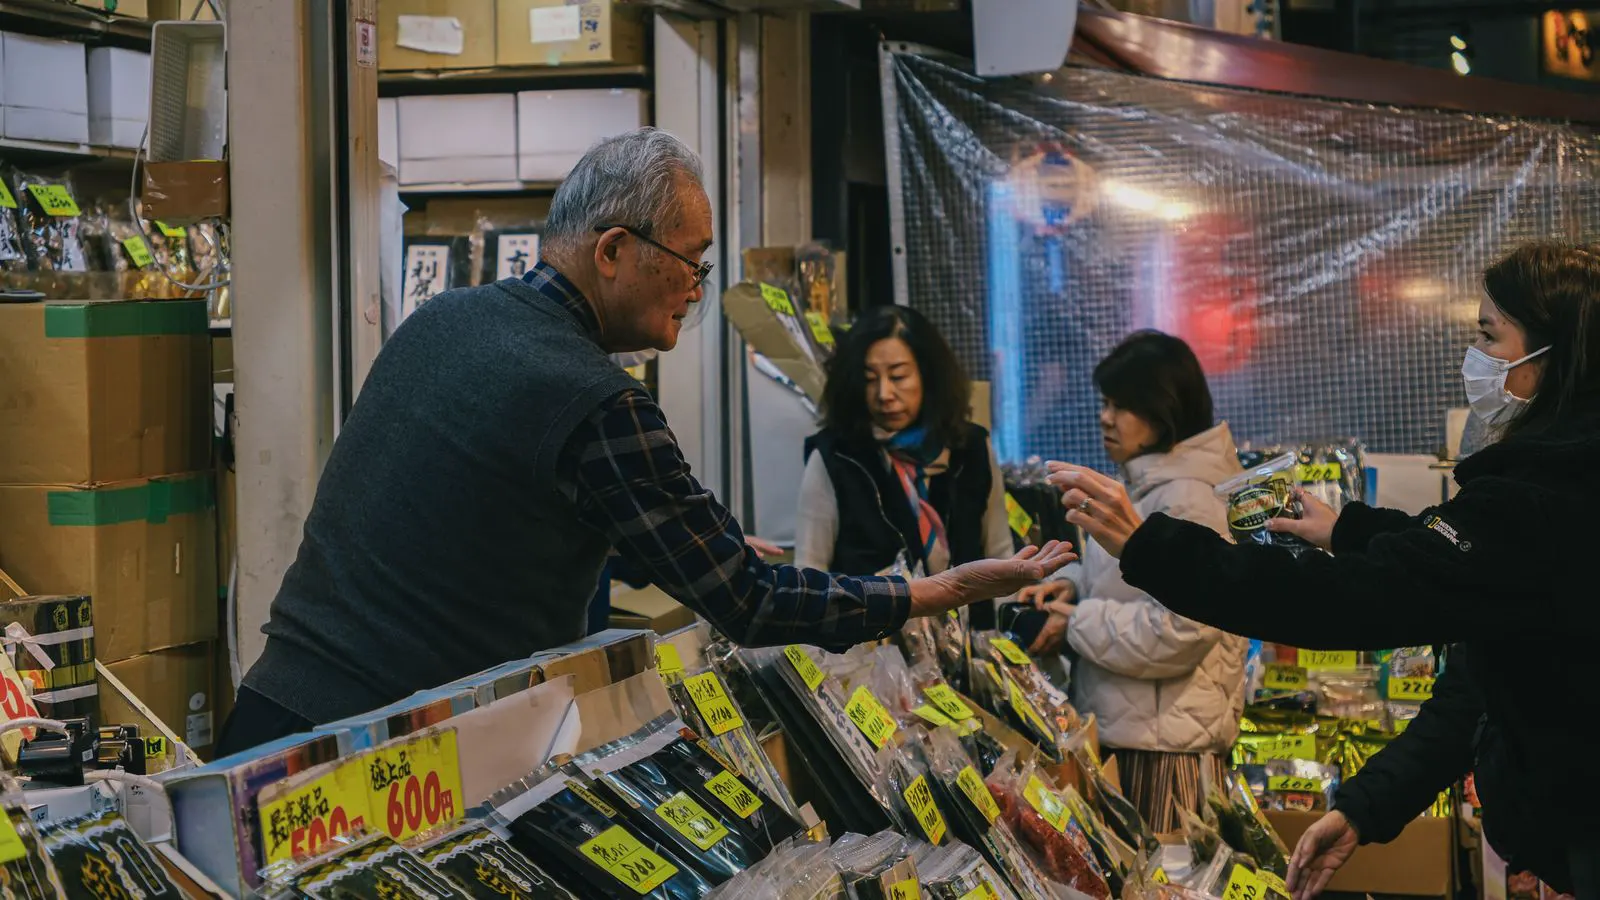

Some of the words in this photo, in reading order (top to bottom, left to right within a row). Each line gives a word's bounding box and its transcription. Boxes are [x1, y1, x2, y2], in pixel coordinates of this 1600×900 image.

[1433, 524, 1460, 546] GEOGRAPHIC
[1439, 520, 1458, 536] NATIONAL
[387, 771, 454, 838] 600円
